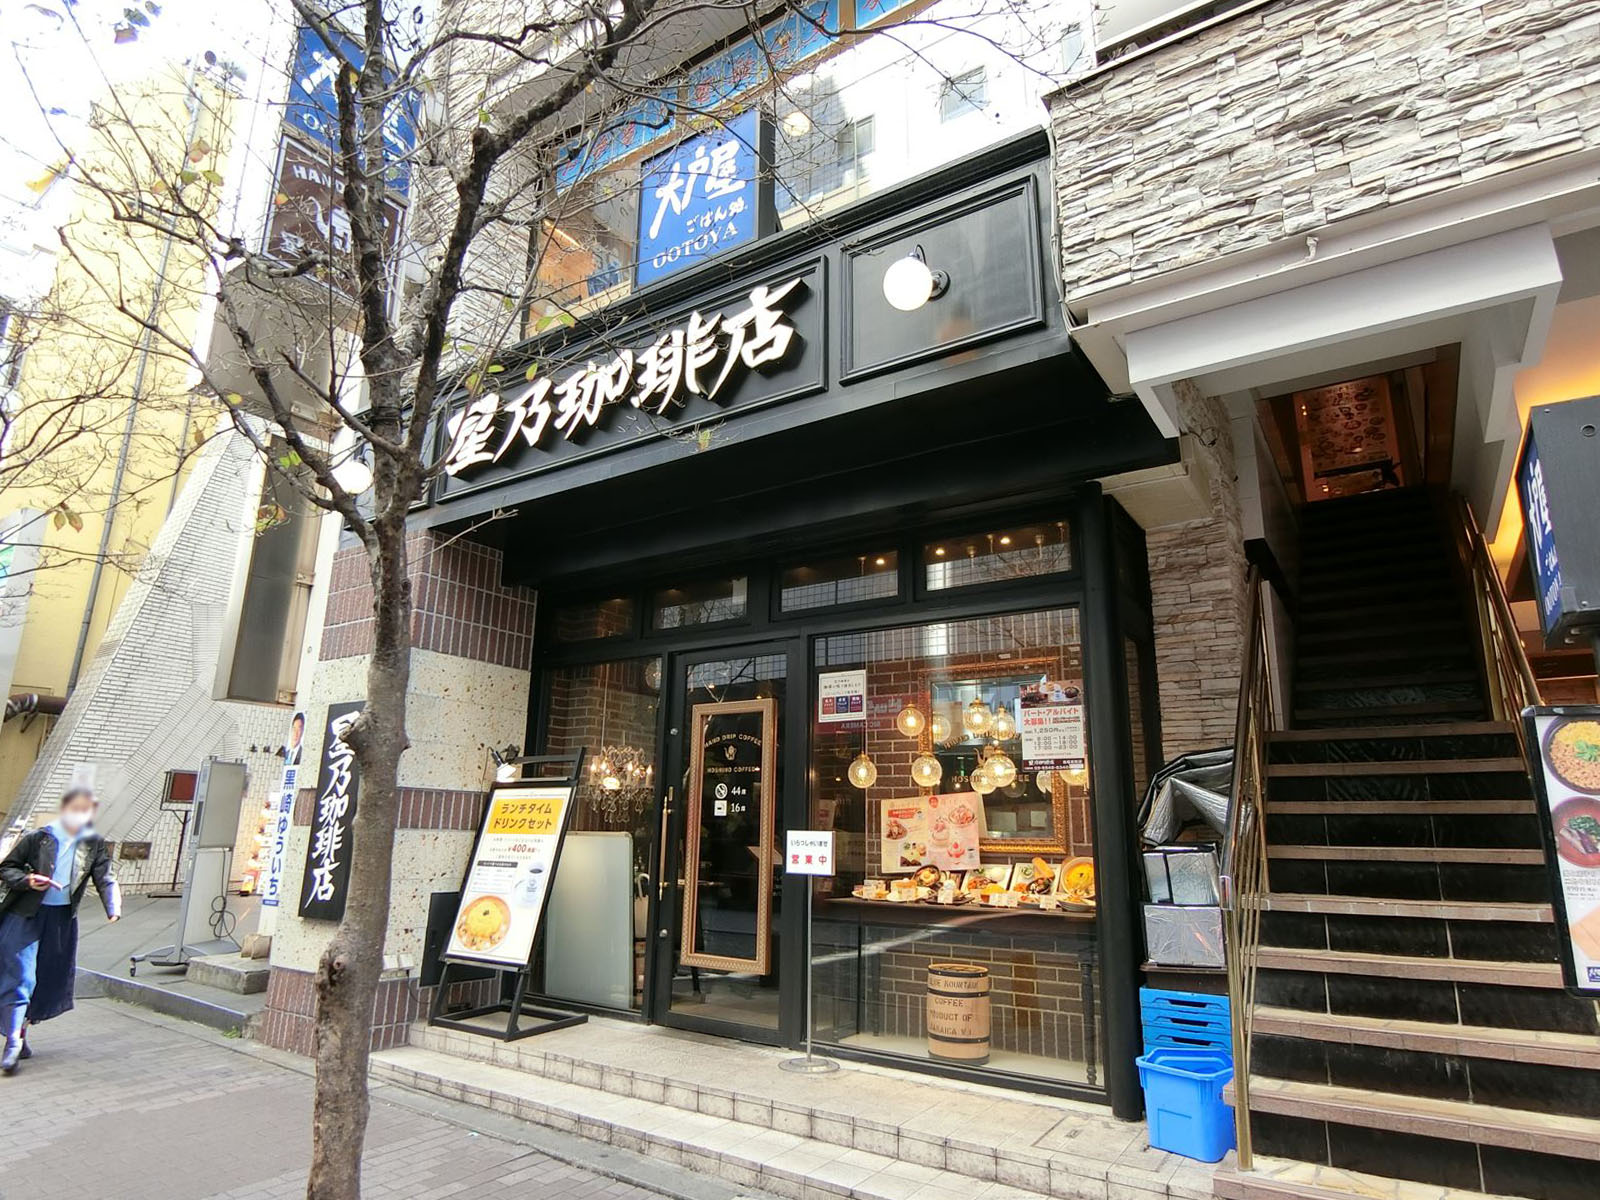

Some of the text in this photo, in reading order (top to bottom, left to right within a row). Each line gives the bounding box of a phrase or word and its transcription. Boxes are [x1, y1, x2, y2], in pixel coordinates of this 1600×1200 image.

[649, 140, 746, 240] 大戸屋
[652, 221, 738, 269] OOTOYA
[445, 277, 802, 476] 星乃珈琲店
[739, 733, 762, 746] COFFEE
[501, 803, 553, 815] ランチタイム
[493, 817, 553, 831] ドリンクセット
[791, 854, 828, 865] 営業中
[935, 998, 964, 1007] COFFEE
[962, 1014, 973, 1022] OF
